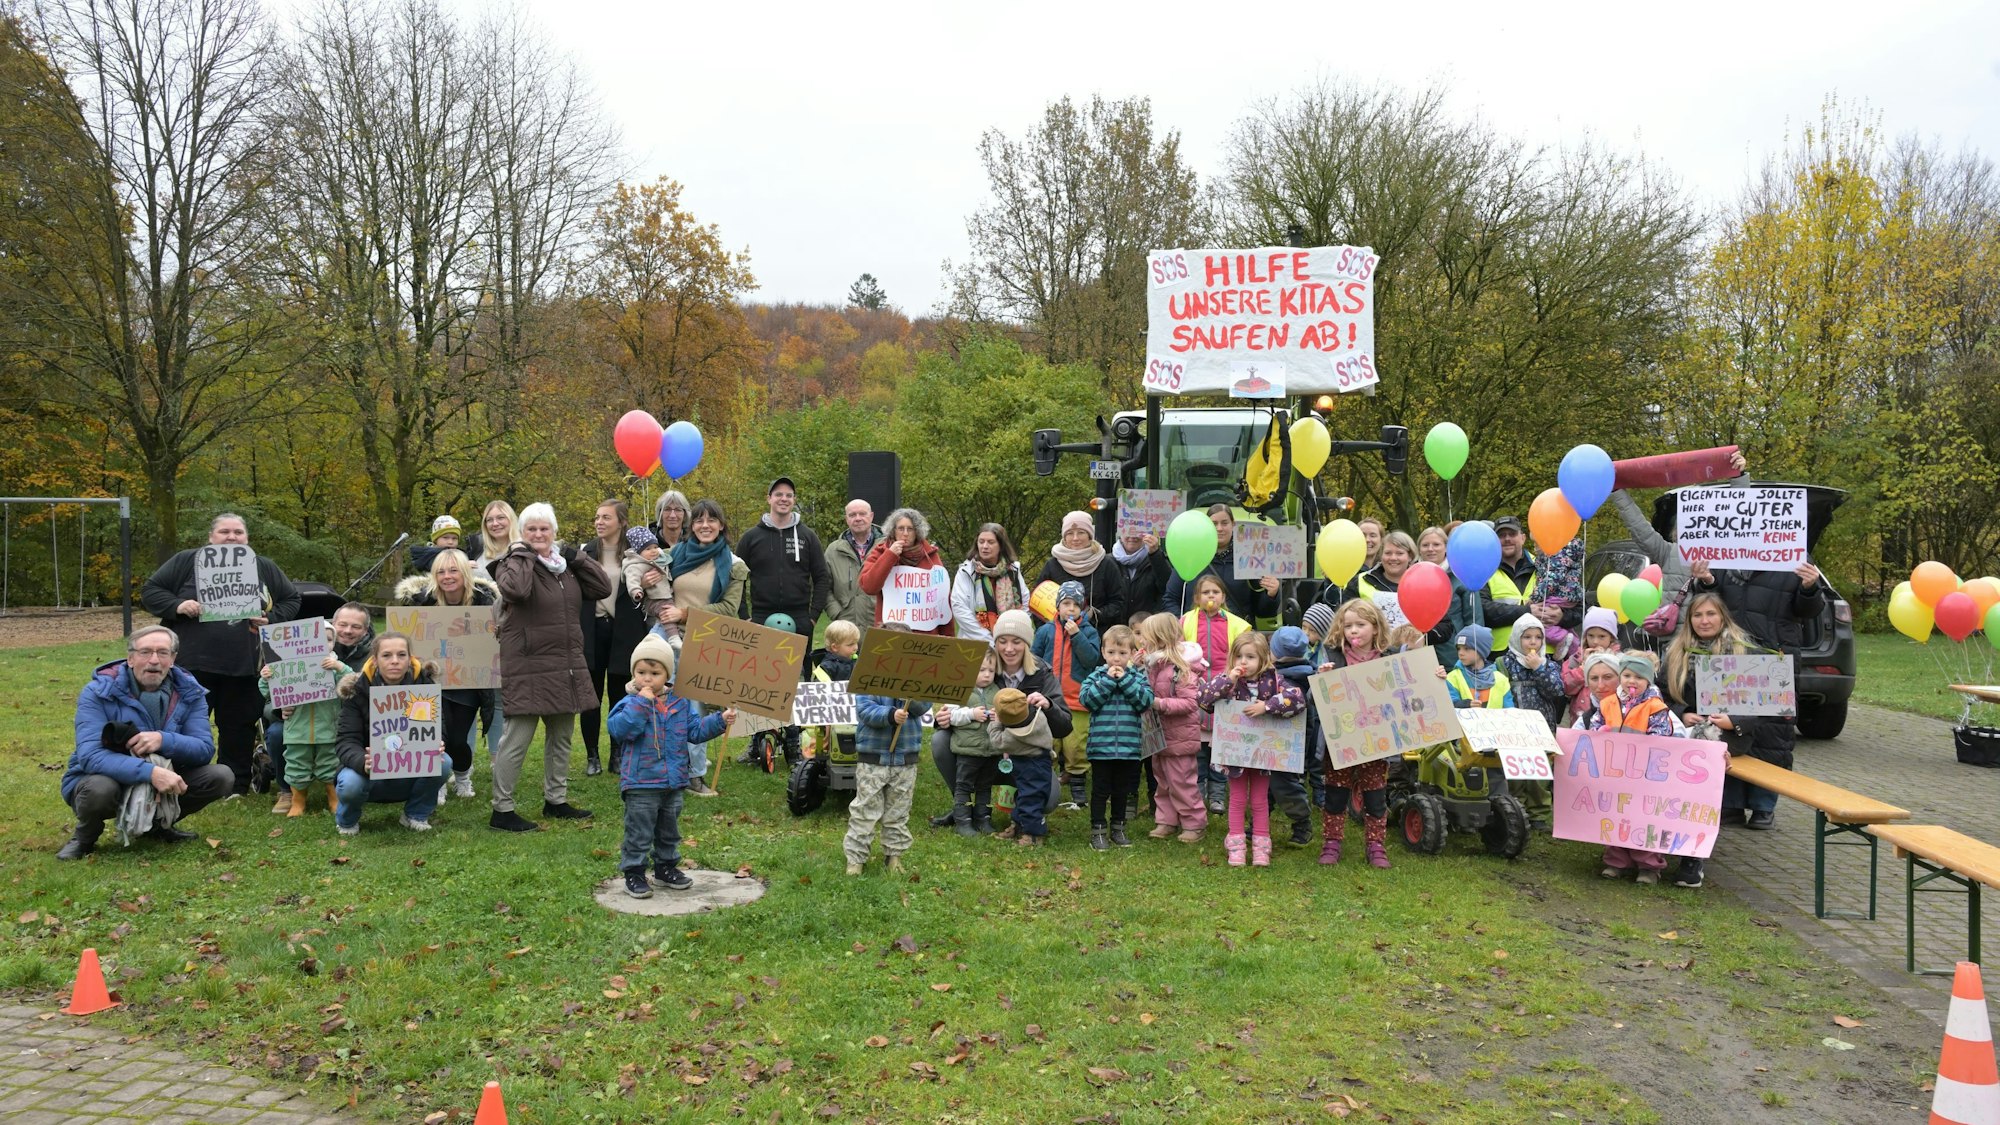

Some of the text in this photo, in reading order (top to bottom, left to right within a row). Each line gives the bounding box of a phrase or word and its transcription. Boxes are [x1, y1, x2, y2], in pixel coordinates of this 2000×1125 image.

[1152, 253, 1190, 284] SOS
[1205, 252, 1311, 287] HILFE
[1336, 247, 1375, 281] SOS
[1168, 289, 1273, 321] UNSERE
[1169, 323, 1290, 353] SAUFEN
[1146, 359, 1184, 390] SOS
[1336, 354, 1374, 387] SOS
[1098, 462, 1108, 470] GL
[1680, 489, 1804, 502] EIGENTLICH SOLLTE
[1682, 501, 1794, 516] HIER EIN GUTER
[1684, 516, 1806, 531] SPRUCH STEHEN,
[1680, 530, 1710, 540] ABER
[1714, 531, 1729, 539] ICH
[1763, 532, 1797, 543] KEINE
[203, 546, 248, 569] R.I.P.
[1251, 541, 1292, 557] MOOS
[1679, 545, 1806, 562] VORBEREITUNGSZEIT
[211, 571, 243, 585] GUTE
[199, 583, 260, 603] PÄDAGOGIK
[905, 591, 921, 604] EIN
[887, 608, 908, 620] AUF
[389, 609, 442, 641] Wir
[720, 623, 761, 644] OHNE
[296, 645, 325, 655] MEHR
[902, 639, 951, 655] OHNE
[269, 660, 307, 679] KITA
[698, 642, 783, 684] KITA'S
[874, 655, 967, 681] KITA'S
[1701, 657, 1737, 672] ICH
[272, 685, 294, 696] AND
[280, 674, 309, 686] COME
[685, 673, 734, 695] ALLES
[856, 674, 976, 699] GEHT ES NICHT
[1318, 656, 1417, 704] Ich will
[273, 688, 328, 708] BURNOUT
[372, 690, 409, 715] WIR
[1329, 694, 1396, 740] jeden
[1392, 688, 1438, 719] Tag
[371, 716, 436, 742] SIND AM
[1360, 729, 1390, 757] die
[1391, 714, 1448, 750] Kita
[1470, 736, 1497, 748] DEN
[372, 749, 441, 774] LIMIT
[1505, 755, 1548, 776] SOS
[1568, 734, 1709, 784] ALLES
[1571, 786, 1720, 827] AUF UNSEREN
